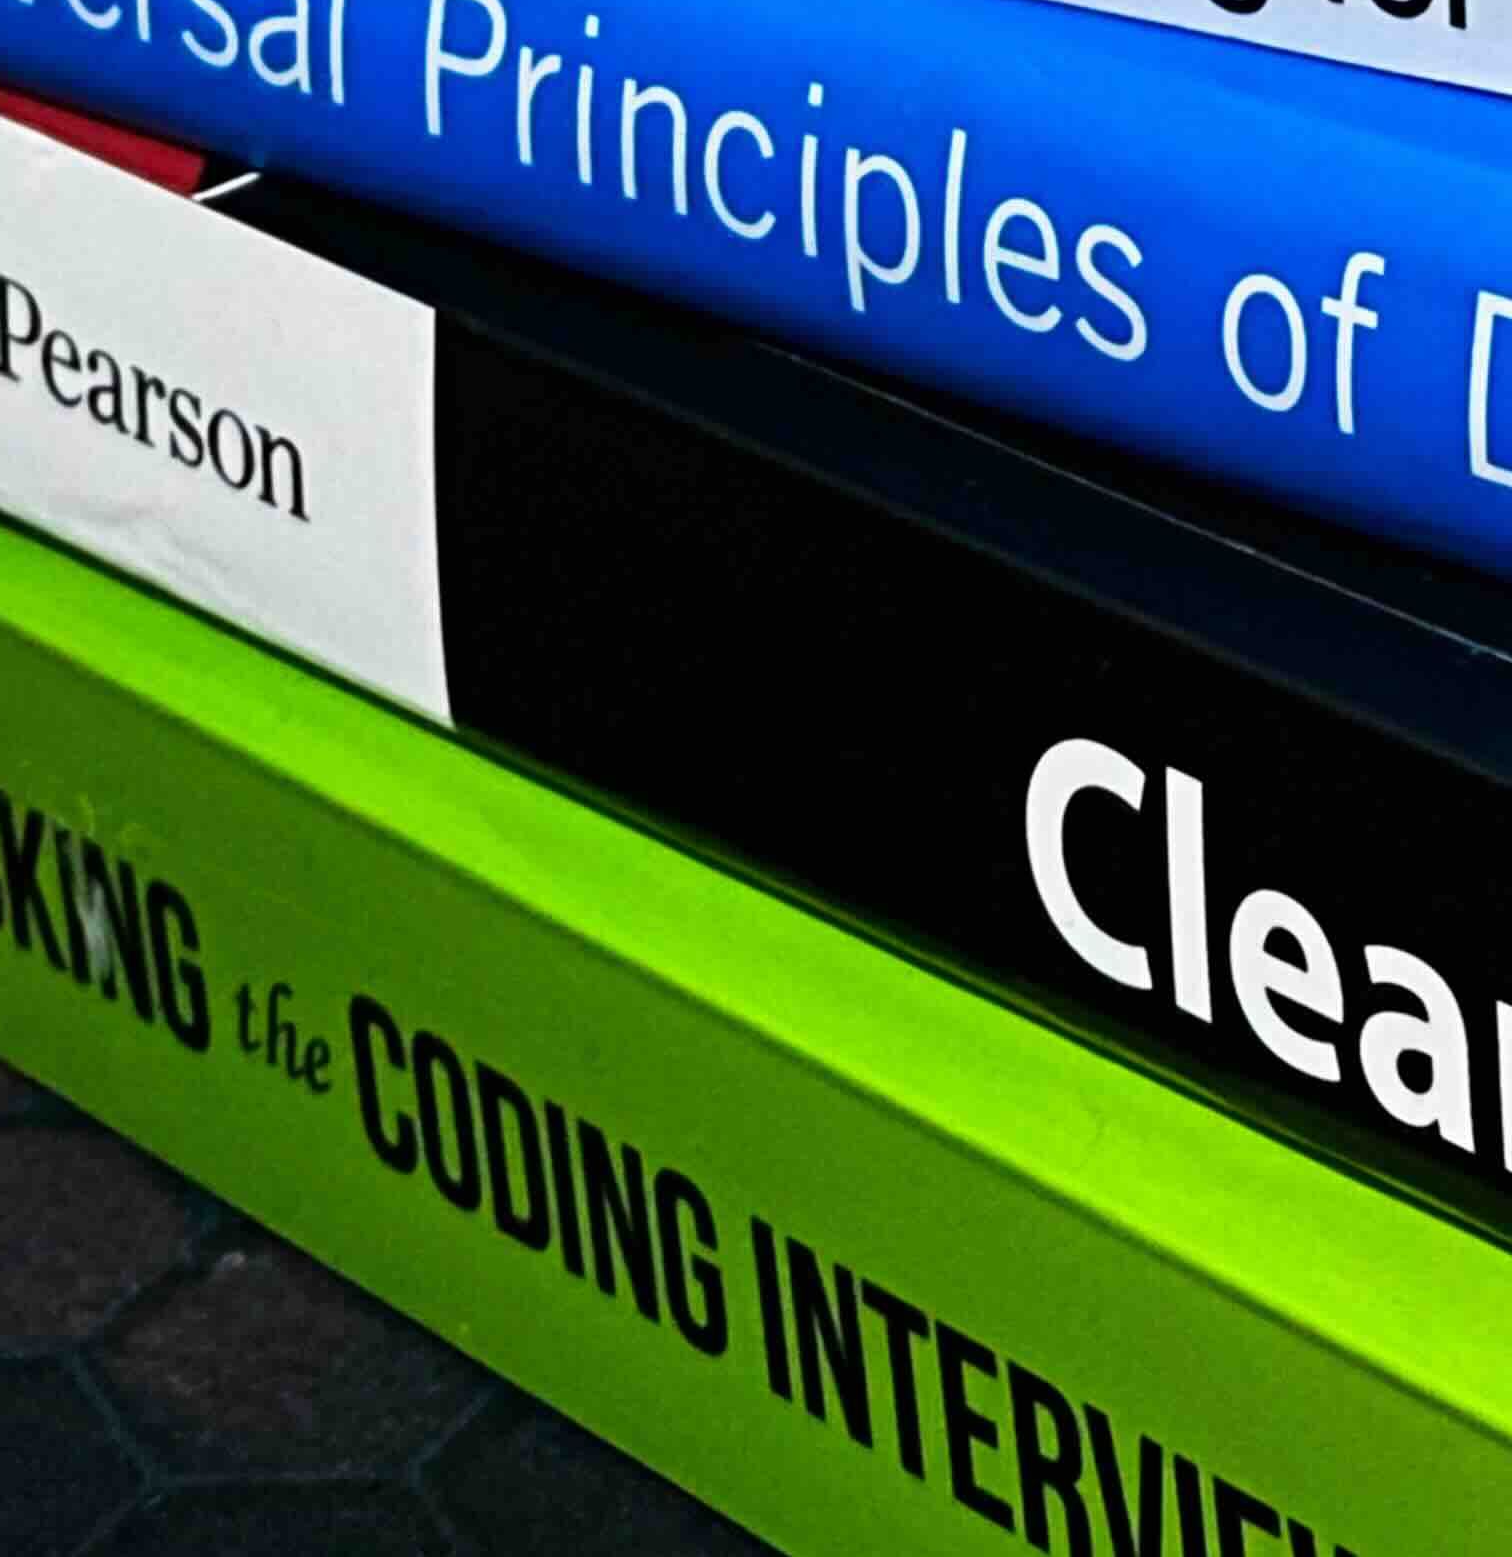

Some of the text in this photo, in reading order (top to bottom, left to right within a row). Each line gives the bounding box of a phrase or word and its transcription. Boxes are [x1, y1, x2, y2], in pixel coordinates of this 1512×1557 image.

[1222, 250, 1387, 436] of
[235, 981, 335, 1097] the
[347, 992, 729, 1362] CODING
